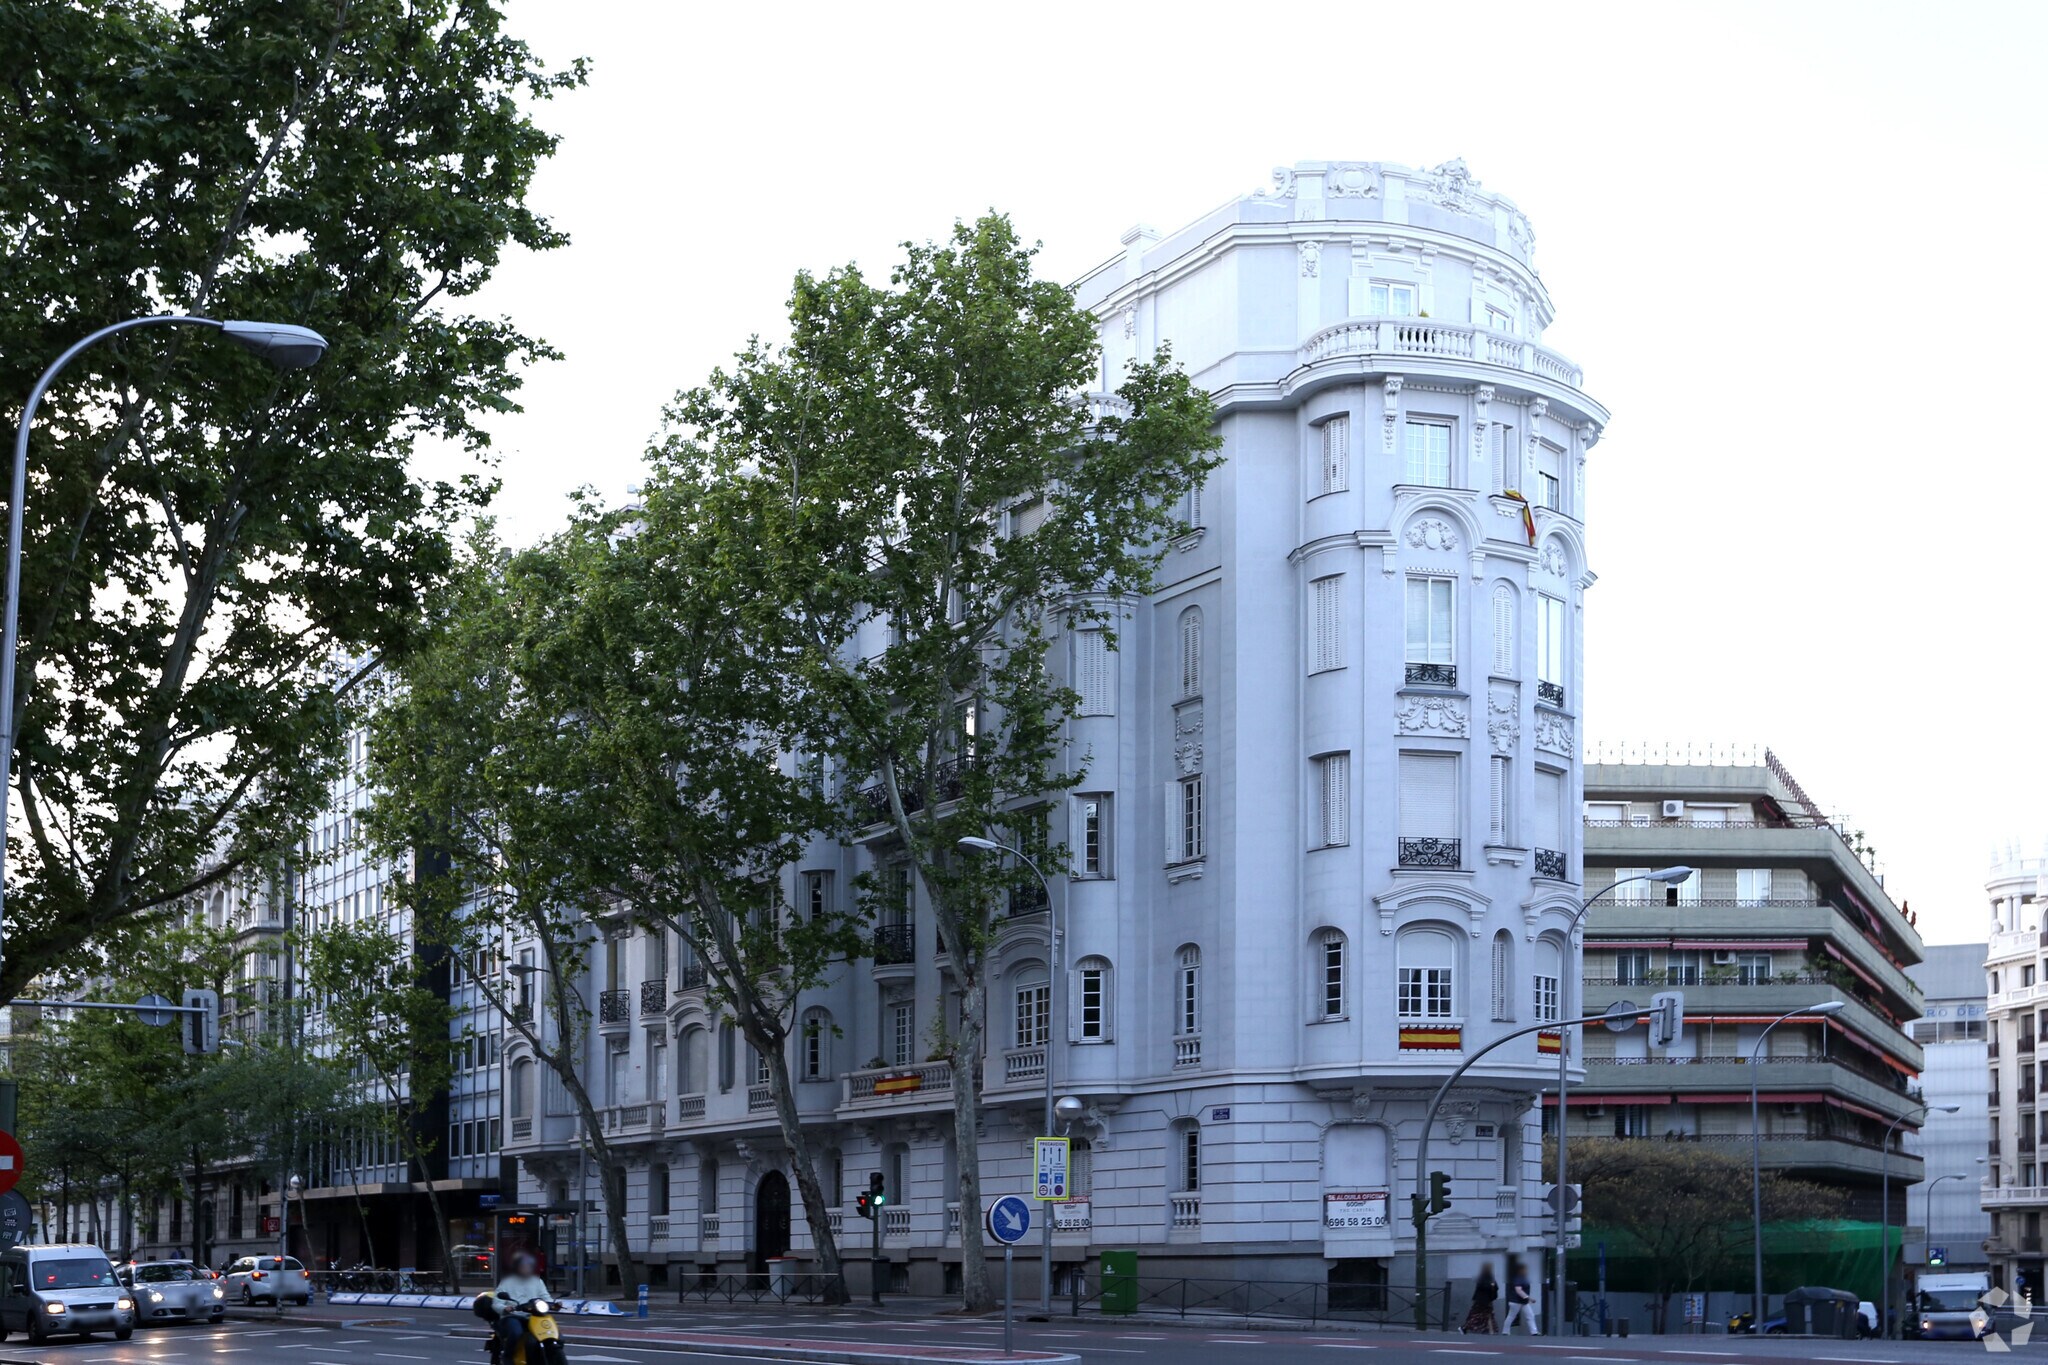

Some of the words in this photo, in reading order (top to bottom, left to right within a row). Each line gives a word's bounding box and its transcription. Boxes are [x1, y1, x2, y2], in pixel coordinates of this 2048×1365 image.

[1072, 1218, 1080, 1227] 25
[1081, 1218, 1090, 1226] 00
[1328, 1218, 1345, 1227] 696
[1347, 1217, 1359, 1226] 58
[1361, 1217, 1373, 1226] 25
[1374, 1216, 1385, 1225] 00
